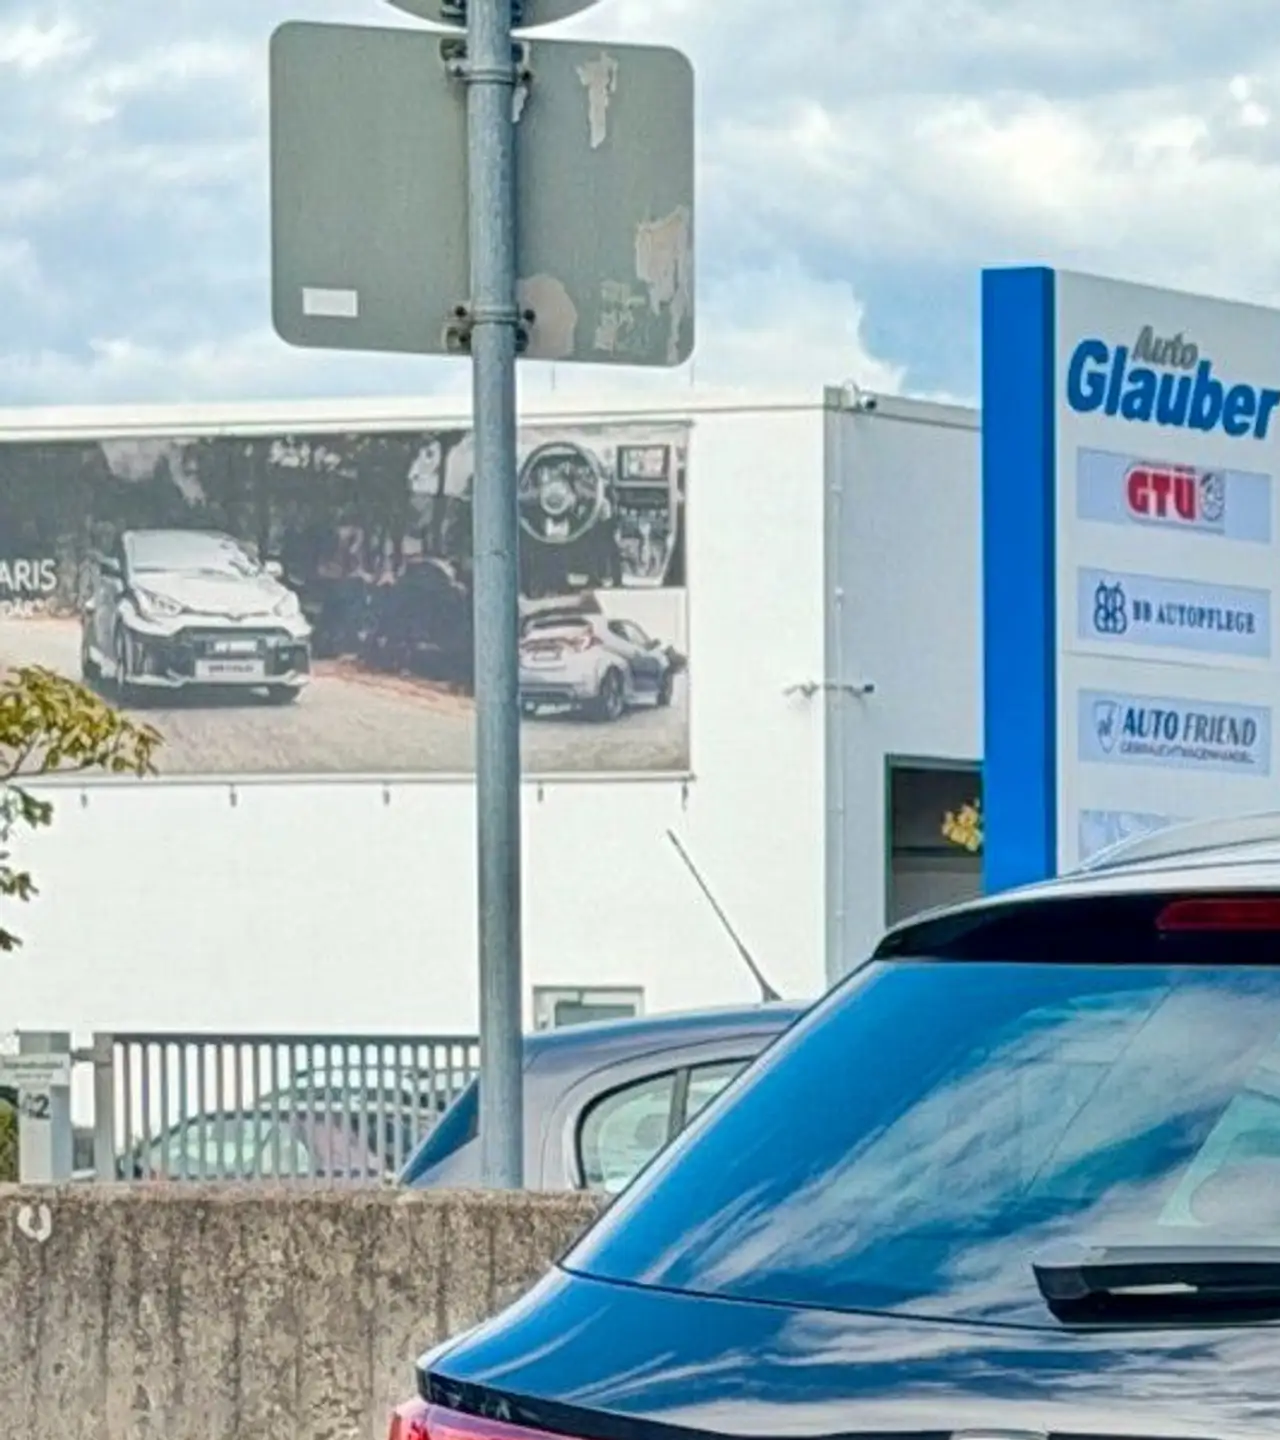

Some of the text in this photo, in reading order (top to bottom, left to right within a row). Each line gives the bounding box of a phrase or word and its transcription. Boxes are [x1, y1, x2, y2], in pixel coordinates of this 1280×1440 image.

[1132, 324, 1198, 369] Auto
[1126, 464, 1196, 520] GTÜ
[1156, 601, 1256, 635] AUTOPFLEGE
[1122, 706, 1179, 741] AUTO
[1183, 712, 1257, 748] FRIEND
